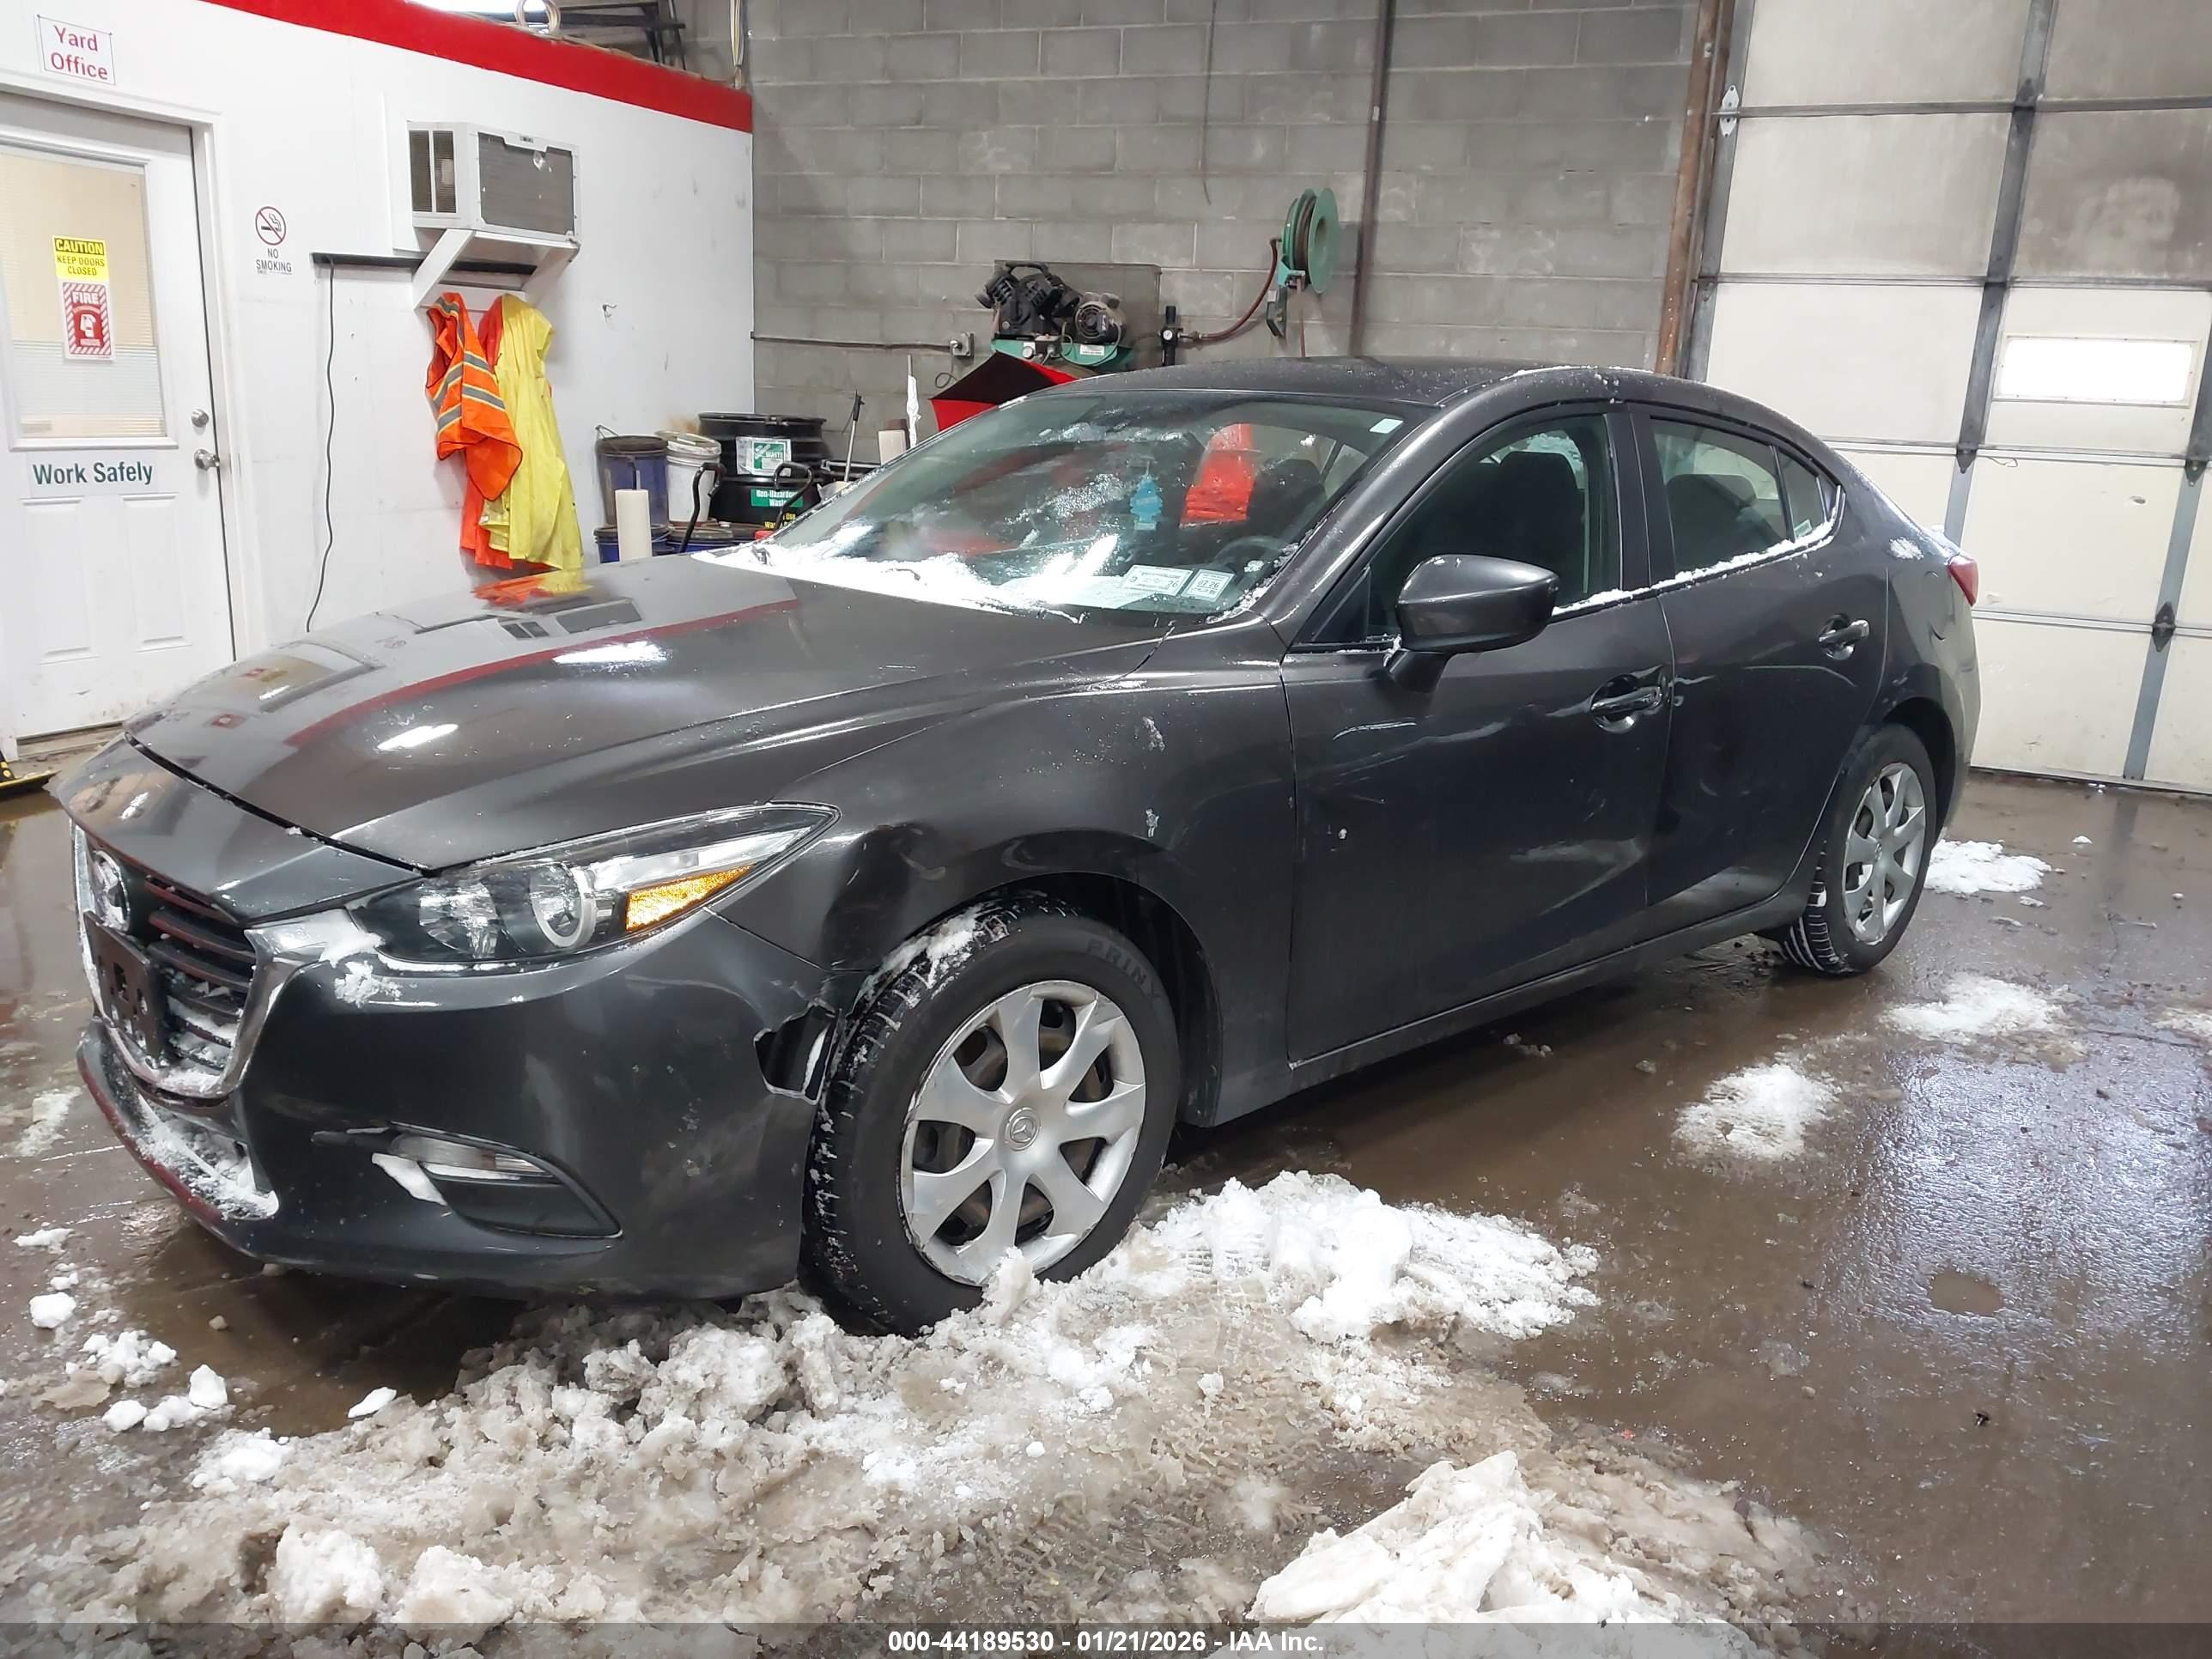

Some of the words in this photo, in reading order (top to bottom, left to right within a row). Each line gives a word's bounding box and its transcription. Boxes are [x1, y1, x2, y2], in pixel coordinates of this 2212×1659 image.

[53, 24, 99, 52] Yard
[50, 52, 108, 81] Office
[55, 238, 105, 256] CAUTION
[267, 247, 280, 259] NO
[57, 254, 76, 265] KEEP
[78, 257, 105, 267] DOORS
[256, 258, 292, 273] SMOKING
[67, 265, 97, 276] CLOSED
[71, 291, 100, 304] FIRE
[765, 451, 783, 459] WASTE
[32, 462, 88, 485] Work
[93, 460, 153, 485] Safely
[756, 489, 797, 498] Non-Hazardou
